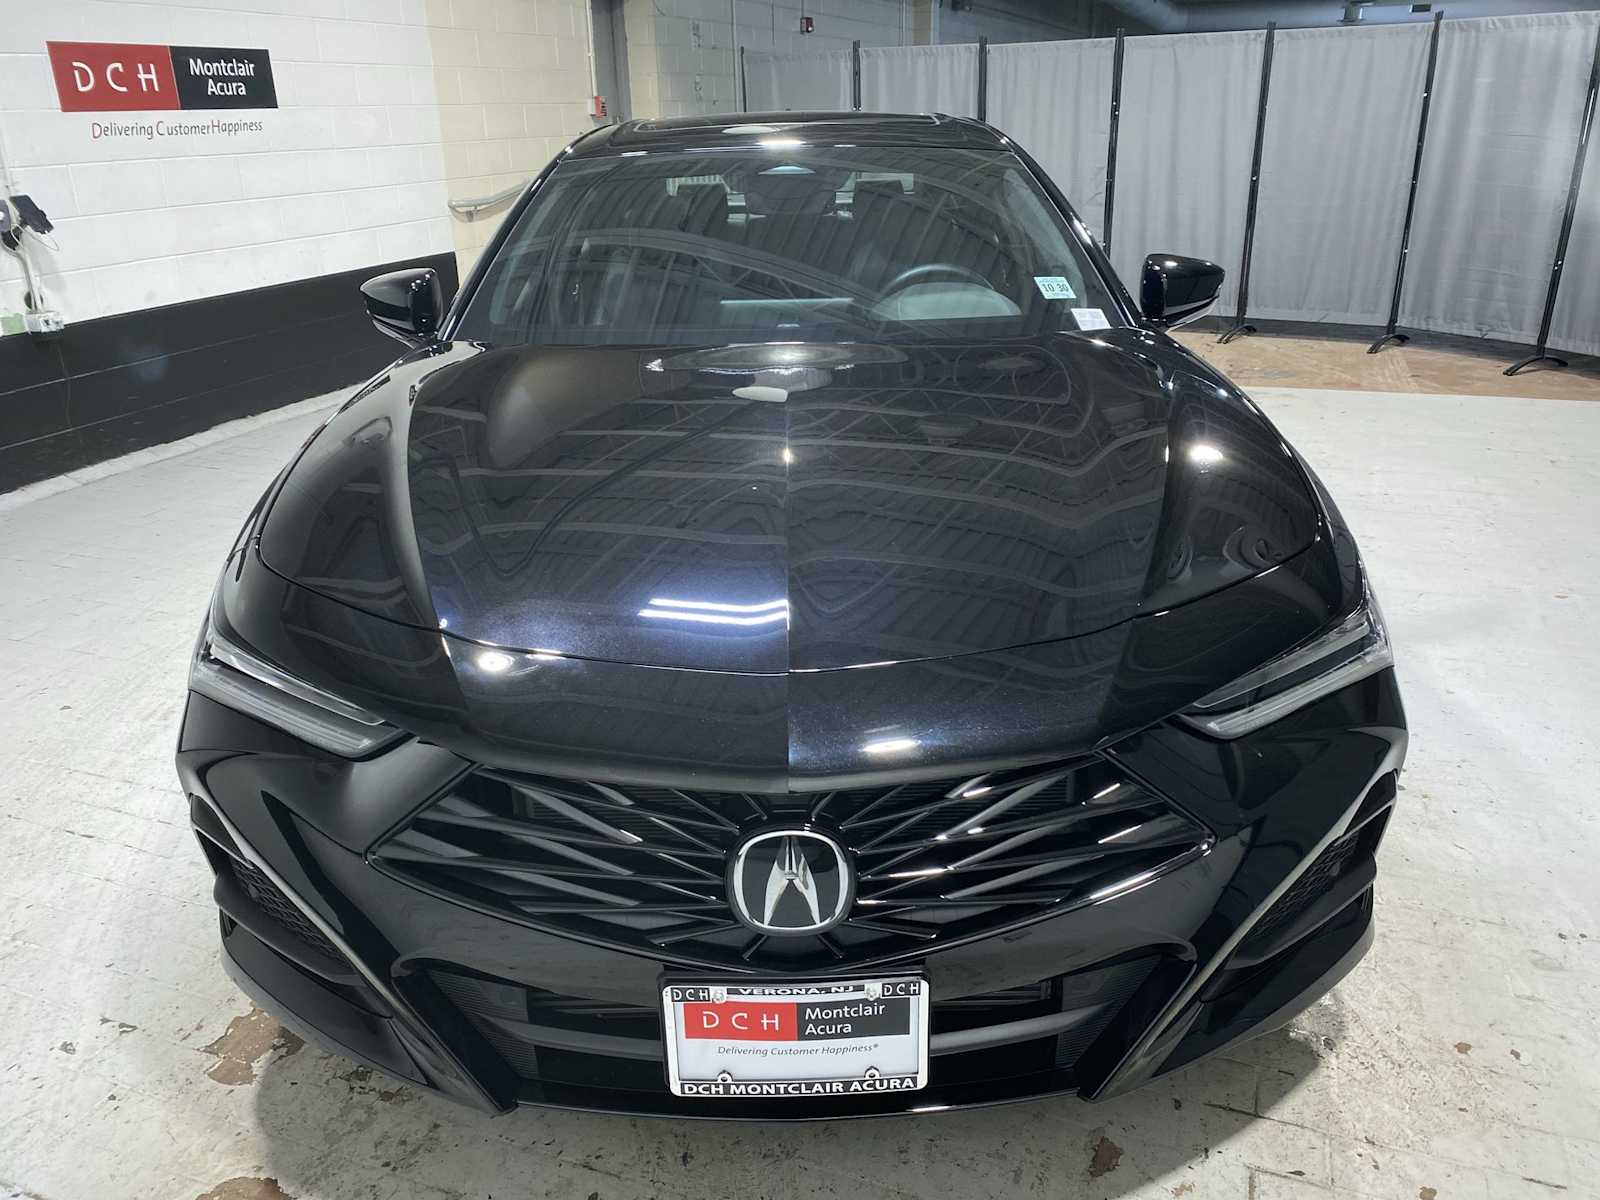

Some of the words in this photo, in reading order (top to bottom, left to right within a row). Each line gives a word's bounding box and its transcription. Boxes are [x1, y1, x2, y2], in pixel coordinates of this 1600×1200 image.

[189, 58, 255, 76] Montclair
[207, 78, 247, 96] Acura
[91, 122, 153, 140] Delivering
[156, 121, 210, 136] Customer
[211, 120, 263, 136] Happiness
[1042, 283, 1055, 292] 10
[831, 985, 854, 993] NJ
[805, 1003, 886, 1020] Montclair
[805, 1023, 852, 1036] Acura
[718, 1046, 768, 1058] Delivering
[770, 1047, 819, 1056] Customer
[684, 1084, 724, 1095] DCH
[729, 1082, 844, 1095] MONTCLAIR
[849, 1078, 914, 1092] ACURA
